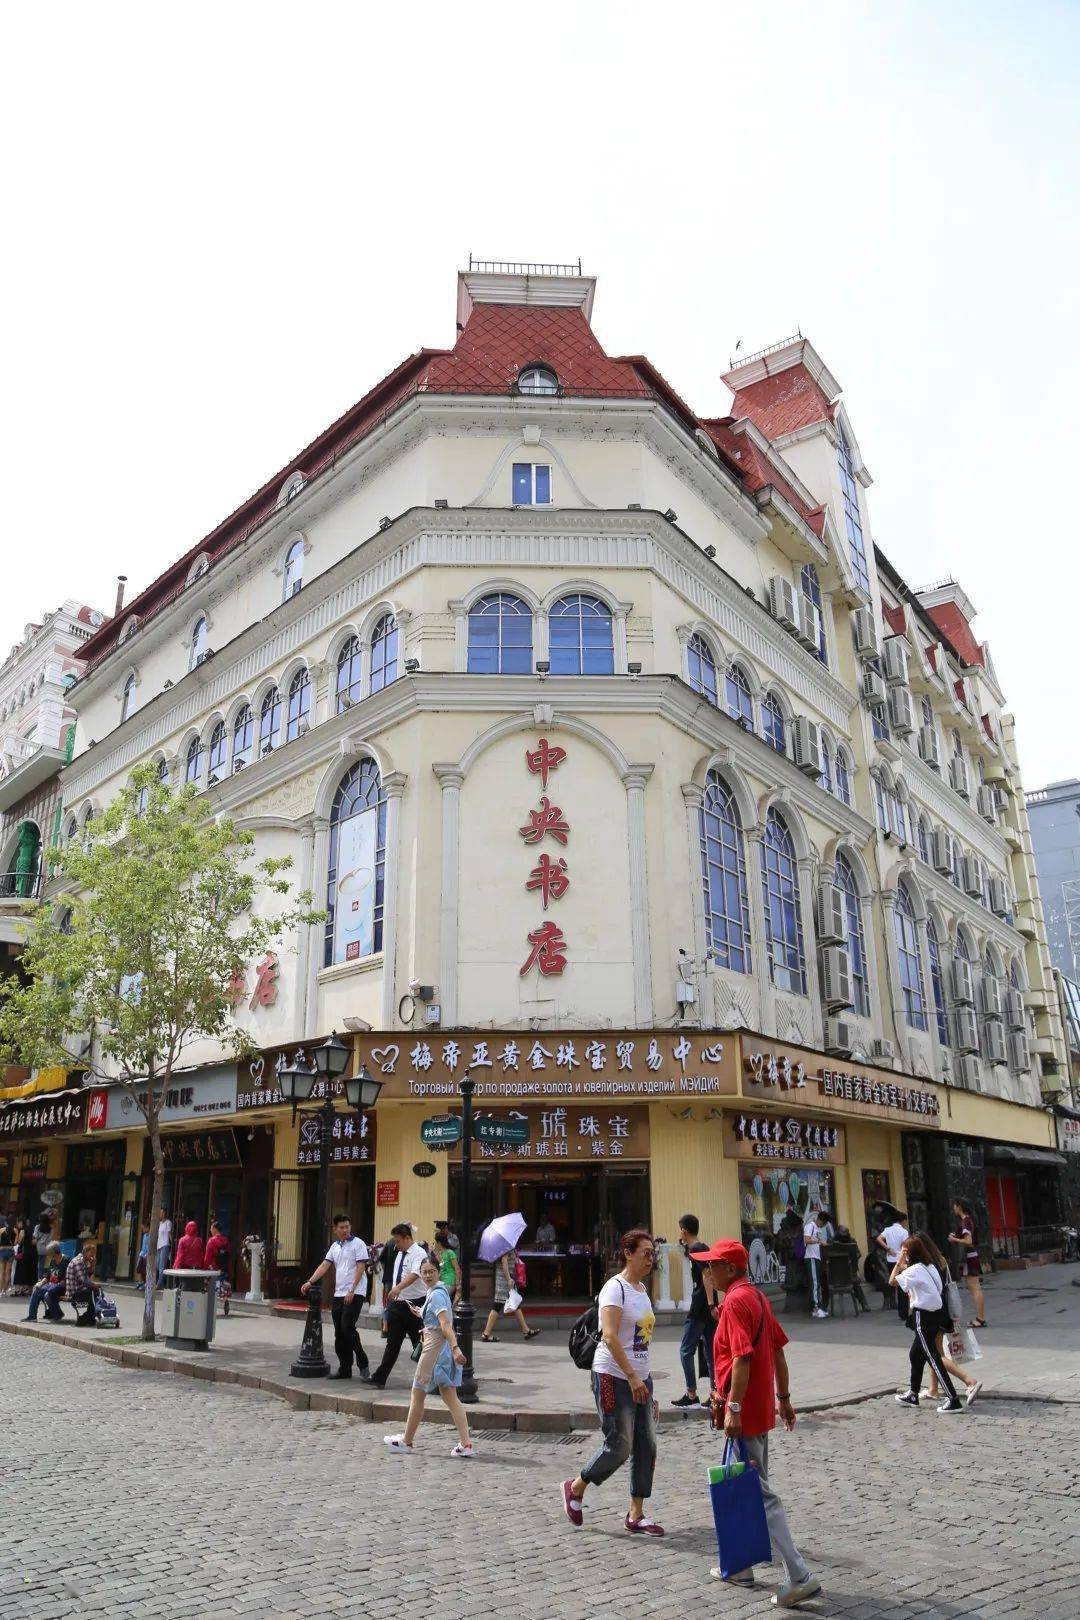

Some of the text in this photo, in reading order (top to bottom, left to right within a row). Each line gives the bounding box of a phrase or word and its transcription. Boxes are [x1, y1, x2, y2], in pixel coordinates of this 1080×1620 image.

[519, 737, 571, 977] 中央书店
[409, 1036, 724, 1073] 梅帝亚黄金珠宝贸易中心
[408, 1080, 454, 1097] Торговый
[485, 1083, 498, 1094] по
[499, 1082, 540, 1097] продаже
[541, 1082, 573, 1094] золота
[575, 1082, 582, 1093] и
[637, 1078, 676, 1094] изделий
